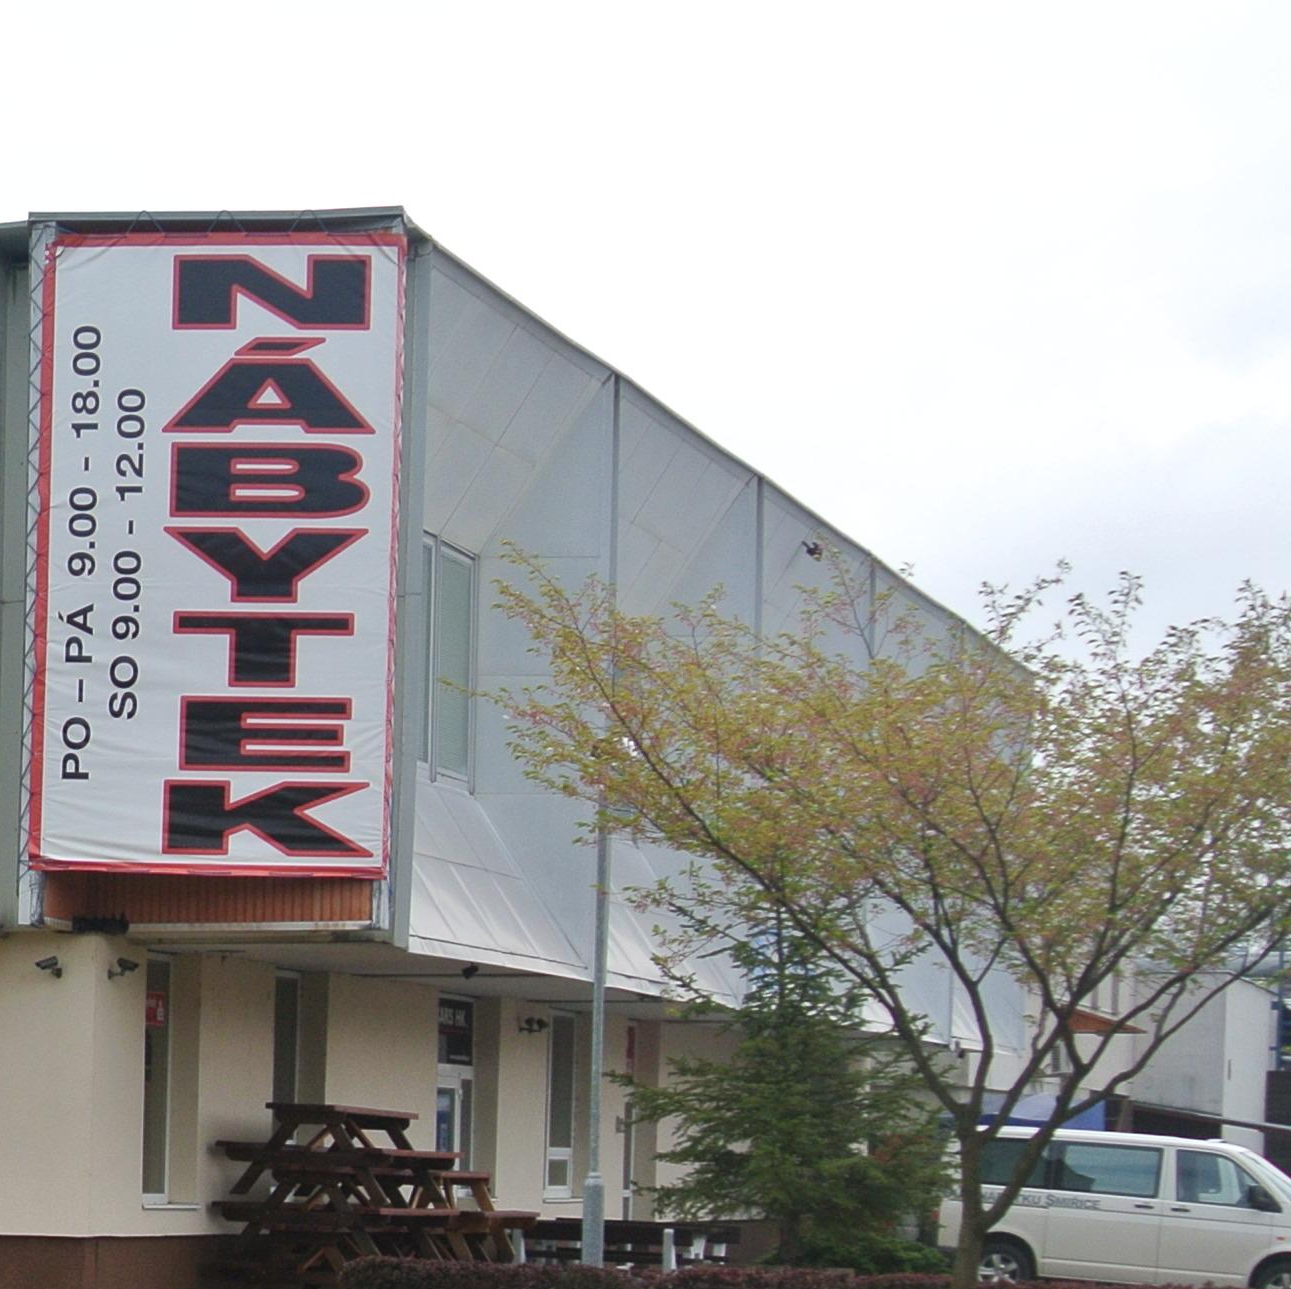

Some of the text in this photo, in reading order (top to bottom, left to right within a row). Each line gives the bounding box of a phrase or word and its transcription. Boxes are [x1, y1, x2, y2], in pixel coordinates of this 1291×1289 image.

[71, 325, 103, 439] 18.00
[115, 387, 148, 502] 12.00
[67, 486, 97, 577] 9.00
[162, 253, 376, 859] NÁBYTEK
[58, 602, 96, 664] PÁ
[112, 550, 142, 641] 9.00
[109, 661, 138, 720] SO
[62, 717, 90, 780] PO
